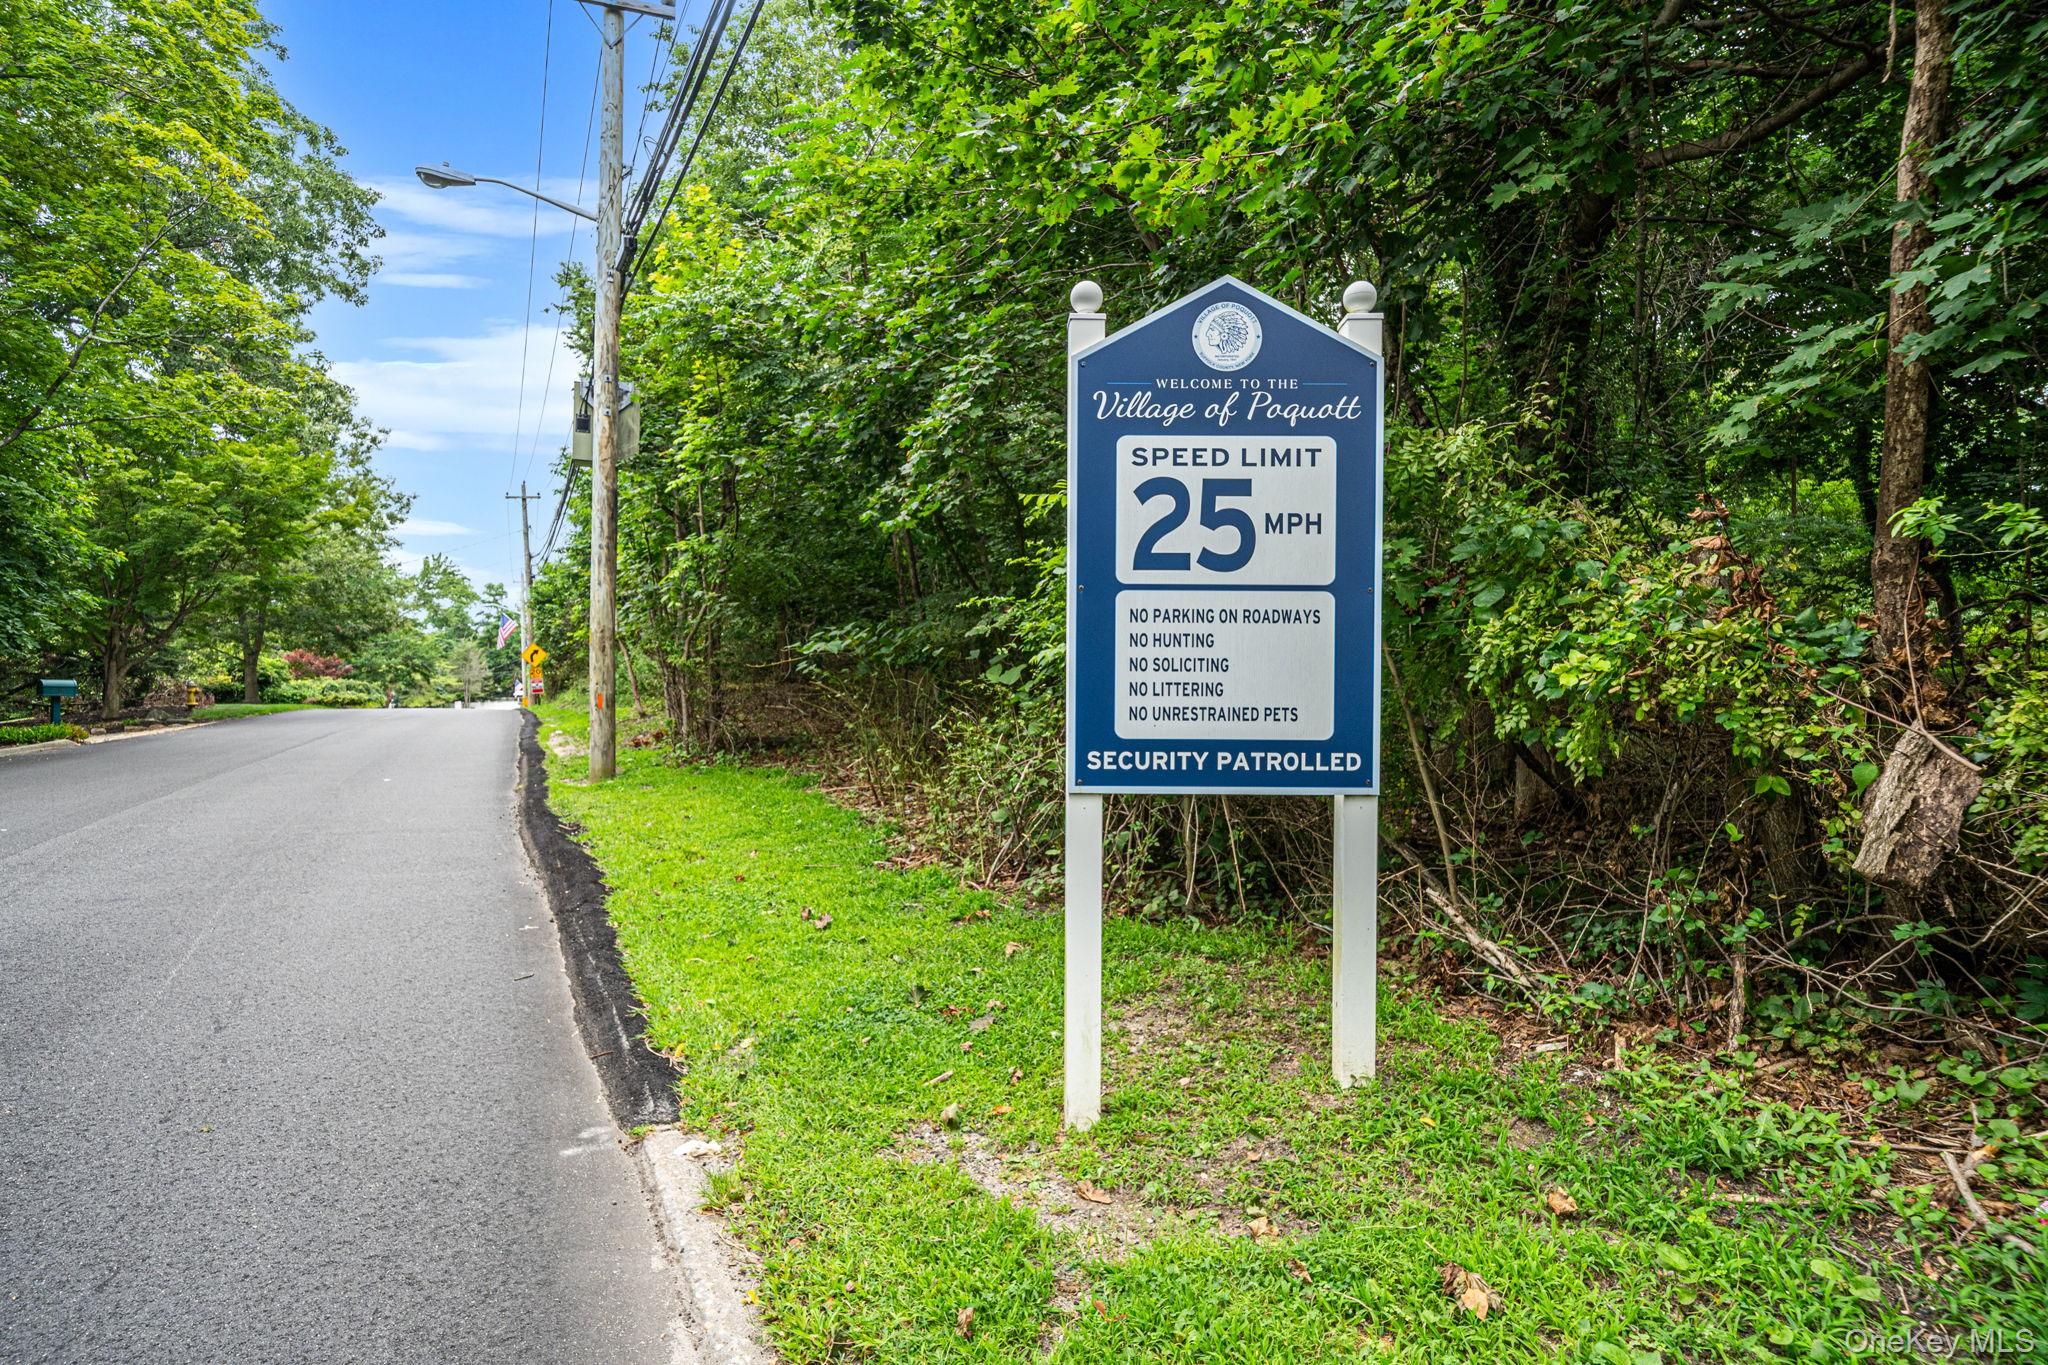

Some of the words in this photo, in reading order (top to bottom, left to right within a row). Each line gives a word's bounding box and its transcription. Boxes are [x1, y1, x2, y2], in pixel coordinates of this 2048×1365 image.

[1197, 304, 1219, 324] VILLAGE
[1231, 303, 1257, 323] POQUOTT
[1156, 379, 1232, 388] WELCOME
[1240, 379, 1259, 388] TO
[1268, 379, 1297, 388] THE
[1093, 391, 1195, 426] Village
[1204, 391, 1238, 427] of
[1248, 392, 1361, 427] Poquott
[1132, 448, 1229, 466] SPEED
[1242, 448, 1321, 467] LIMIT
[1133, 477, 1256, 572] 25
[1265, 513, 1321, 534] MPH
[1130, 609, 1148, 623] NO
[1154, 609, 1214, 623] PARKING
[1219, 609, 1237, 623] ON
[1243, 609, 1320, 624] ROADWAYS
[1130, 633, 1148, 647] NO
[1154, 633, 1214, 648] HUNTING
[1130, 658, 1147, 671] NO
[1153, 658, 1228, 672] SOLICITING
[1130, 682, 1147, 696] NO
[1153, 682, 1223, 697] LITTERING
[1130, 707, 1147, 720] NO
[1153, 707, 1259, 721] UNRESTRAINED
[1265, 708, 1298, 722] PETS
[1087, 751, 1208, 770] SECURITY
[1218, 752, 1361, 771] PATROLLED
